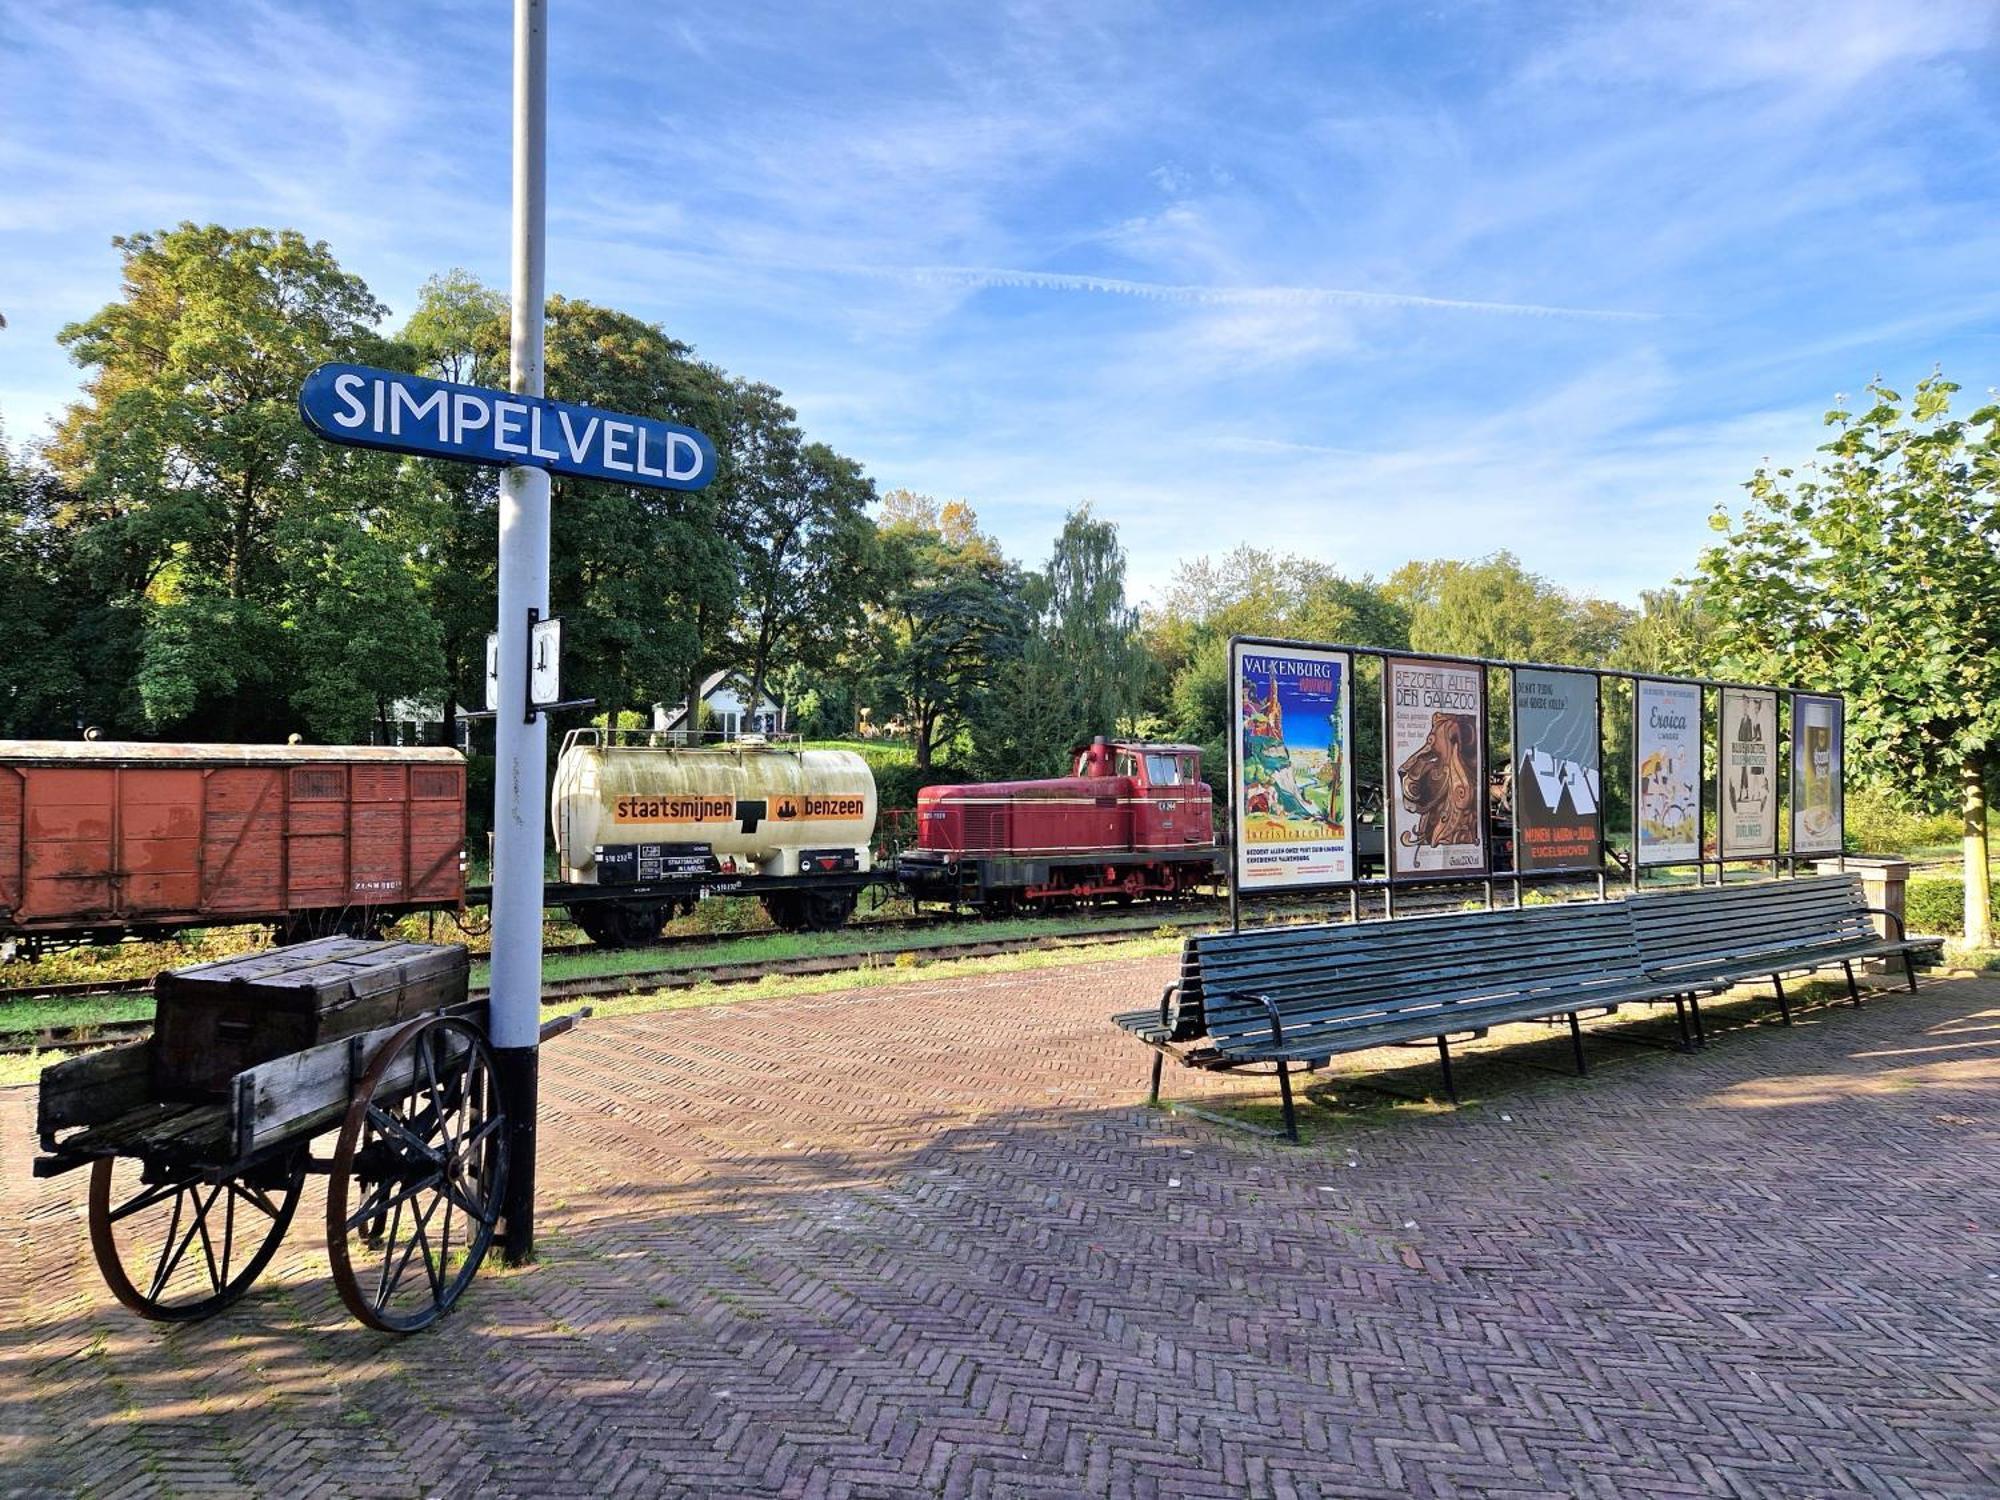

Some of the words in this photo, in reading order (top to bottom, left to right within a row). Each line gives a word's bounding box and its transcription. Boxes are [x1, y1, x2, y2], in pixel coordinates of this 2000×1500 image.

[333, 374, 704, 481] SIMPELVELD
[1244, 658, 1331, 678] VALKENBURG
[1396, 671, 1444, 689] BEZOEKT
[1396, 689, 1419, 707] DEN
[1650, 705, 1687, 730] Eroica
[618, 799, 732, 821] staatsmijnen
[804, 797, 864, 815] benzeen
